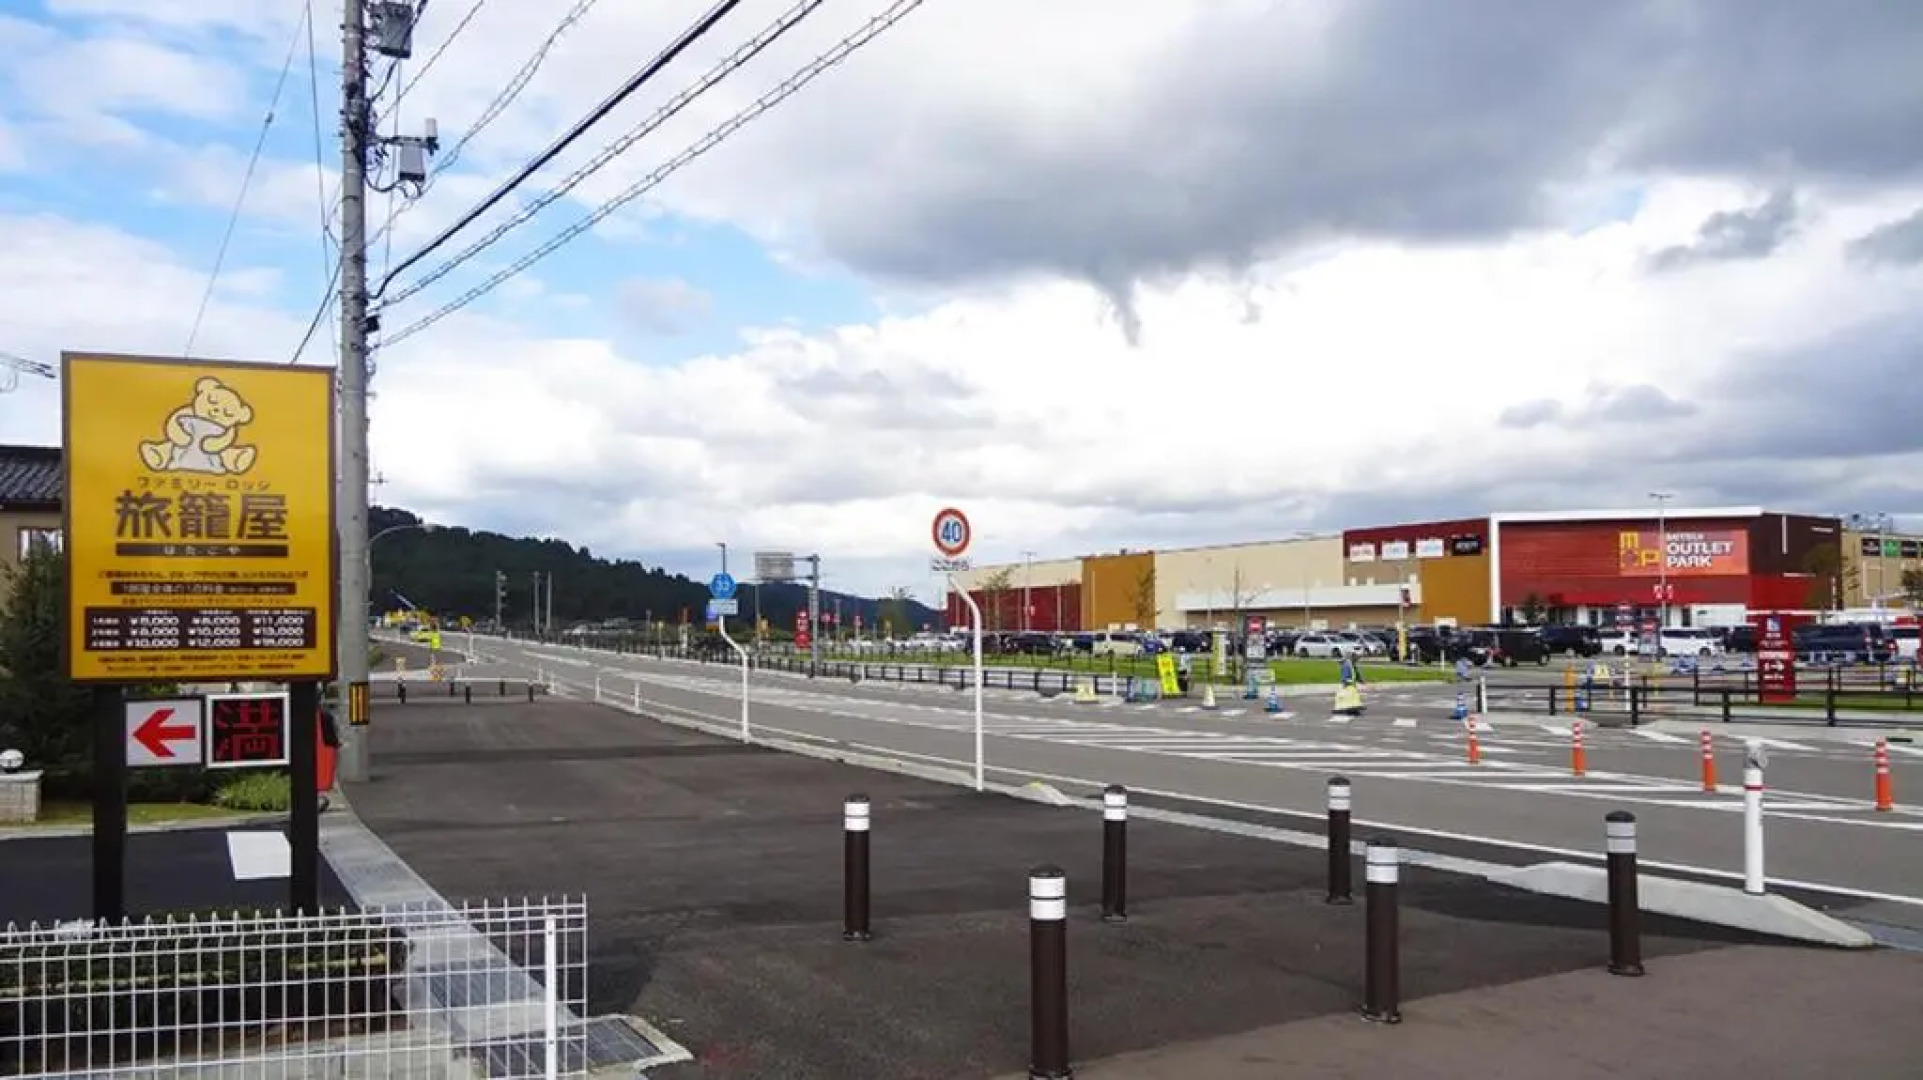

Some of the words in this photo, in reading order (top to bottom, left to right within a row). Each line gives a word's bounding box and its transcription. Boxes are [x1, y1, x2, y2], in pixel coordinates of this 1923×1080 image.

[115, 489, 289, 540] 旅籠屋
[942, 520, 962, 542] 40
[1667, 541, 1734, 555] OUTLET
[1667, 555, 1712, 568] PARK
[215, 699, 280, 762] 満
